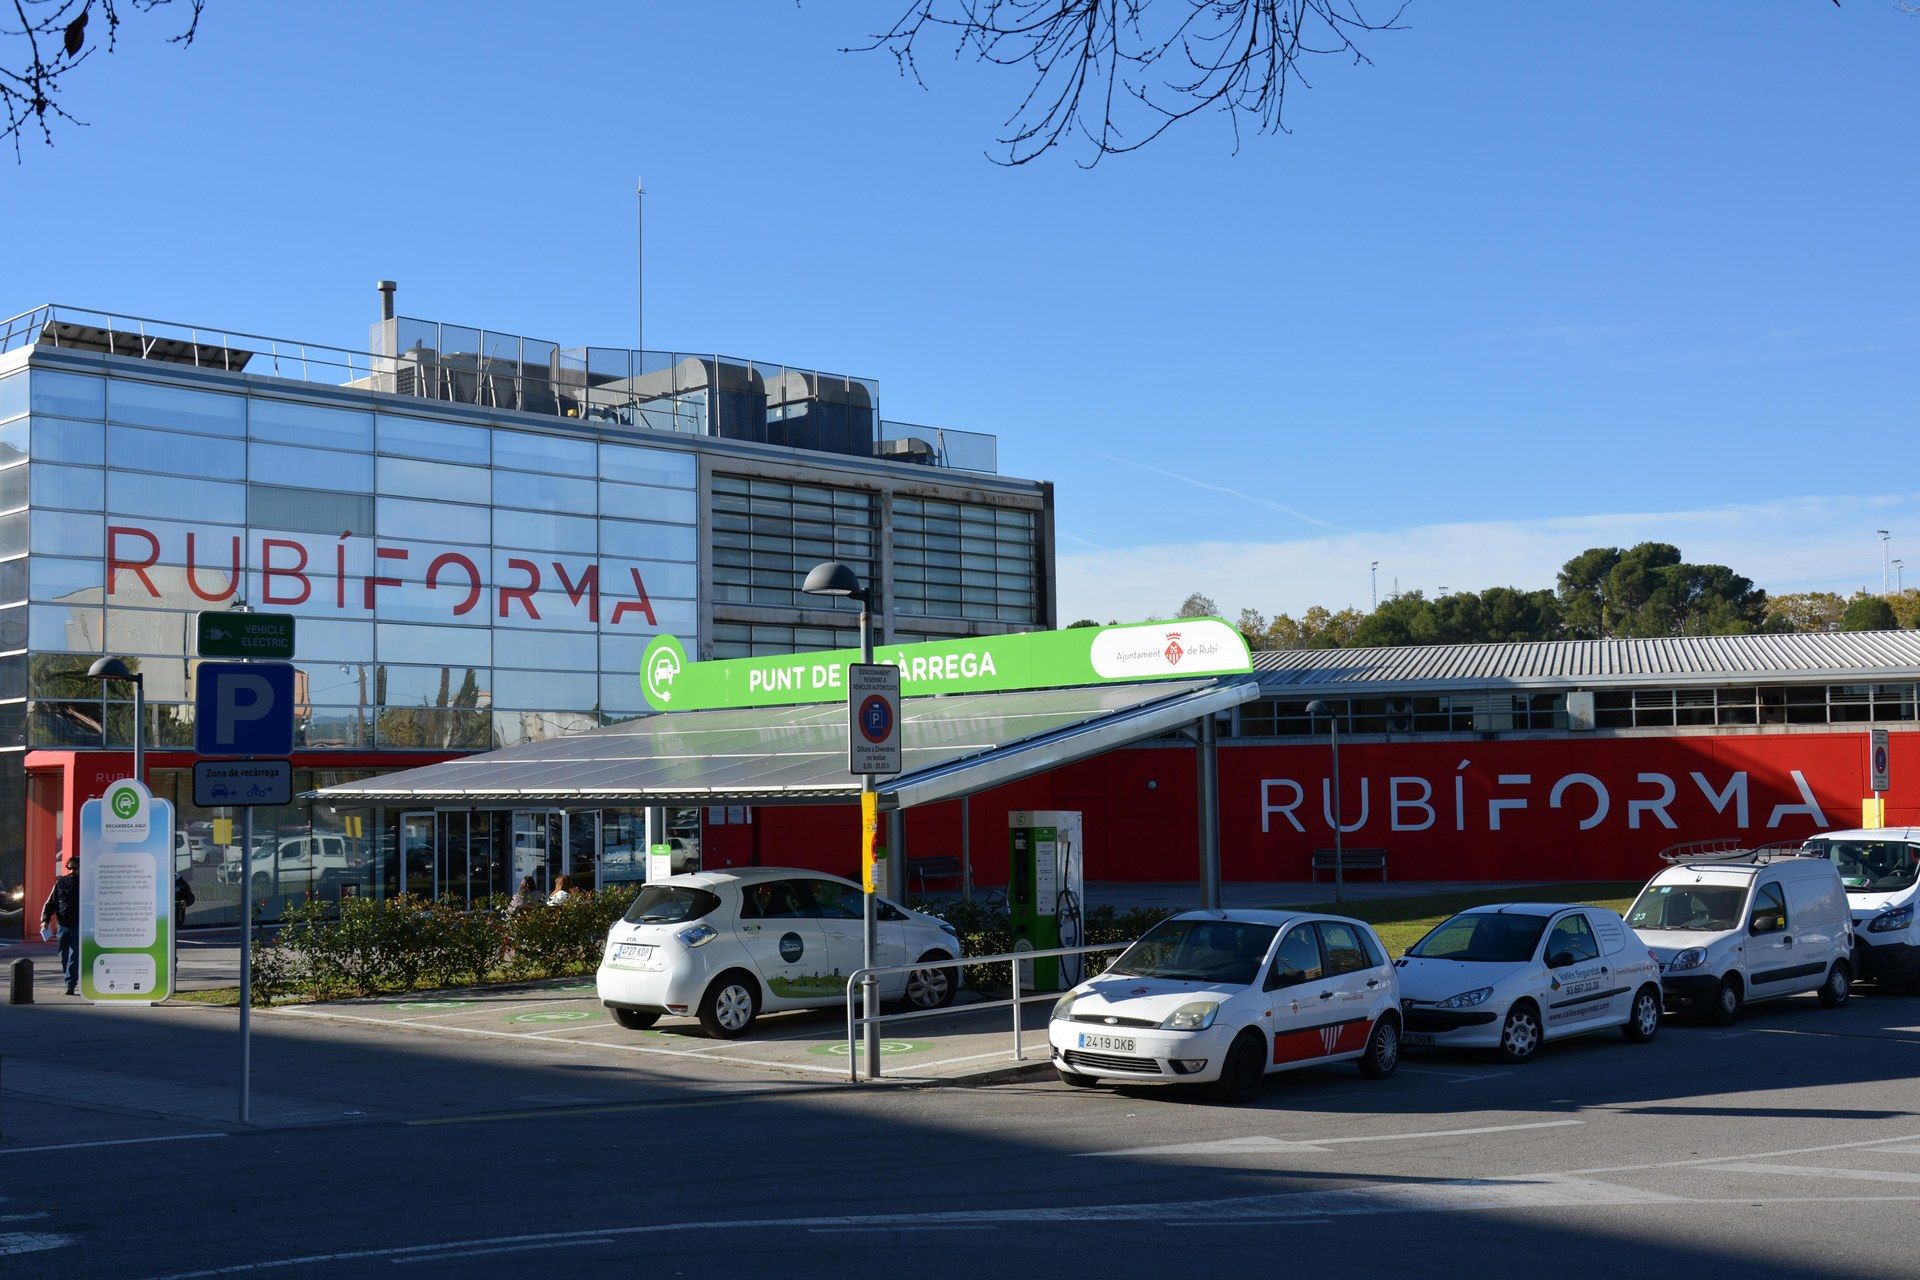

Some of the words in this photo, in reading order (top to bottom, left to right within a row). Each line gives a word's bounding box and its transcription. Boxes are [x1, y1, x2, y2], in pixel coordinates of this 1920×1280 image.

[244, 624, 286, 635] VEHICLE
[1115, 650, 1161, 663] Ajuntament
[1186, 645, 1197, 655] de
[1198, 643, 1218, 654] Rubí
[749, 666, 806, 692] PUNT
[811, 663, 842, 689] DE
[873, 651, 997, 682] ÀRREGA
[216, 673, 275, 745] P
[872, 712, 880, 725] P
[206, 768, 226, 778] Zona
[228, 768, 239, 778] de
[1633, 912, 1646, 921] 23
[1086, 1035, 1111, 1049] 2419
[1113, 1037, 1135, 1051] DKB
